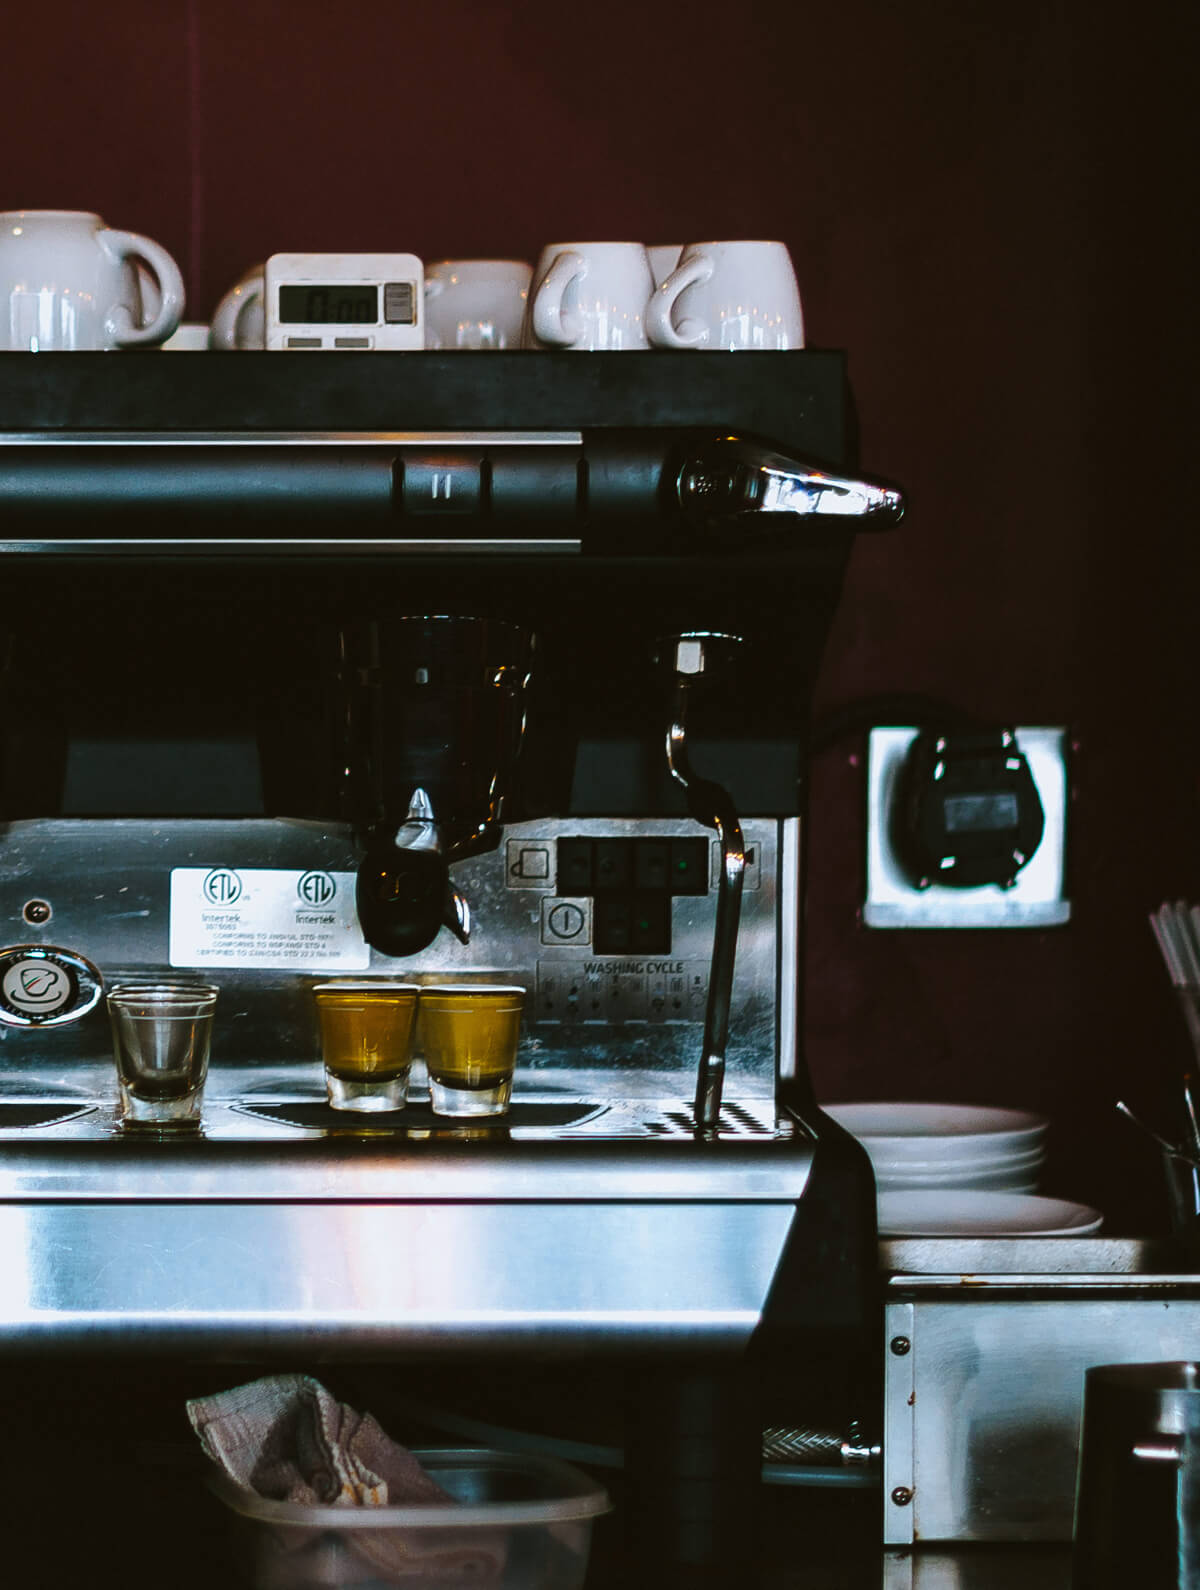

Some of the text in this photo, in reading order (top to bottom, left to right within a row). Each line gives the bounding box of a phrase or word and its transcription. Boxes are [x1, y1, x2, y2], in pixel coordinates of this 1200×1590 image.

[202, 913, 241, 923] Intertek
[295, 914, 336, 925] Intertek
[583, 962, 685, 975] WASHING CYCLE
